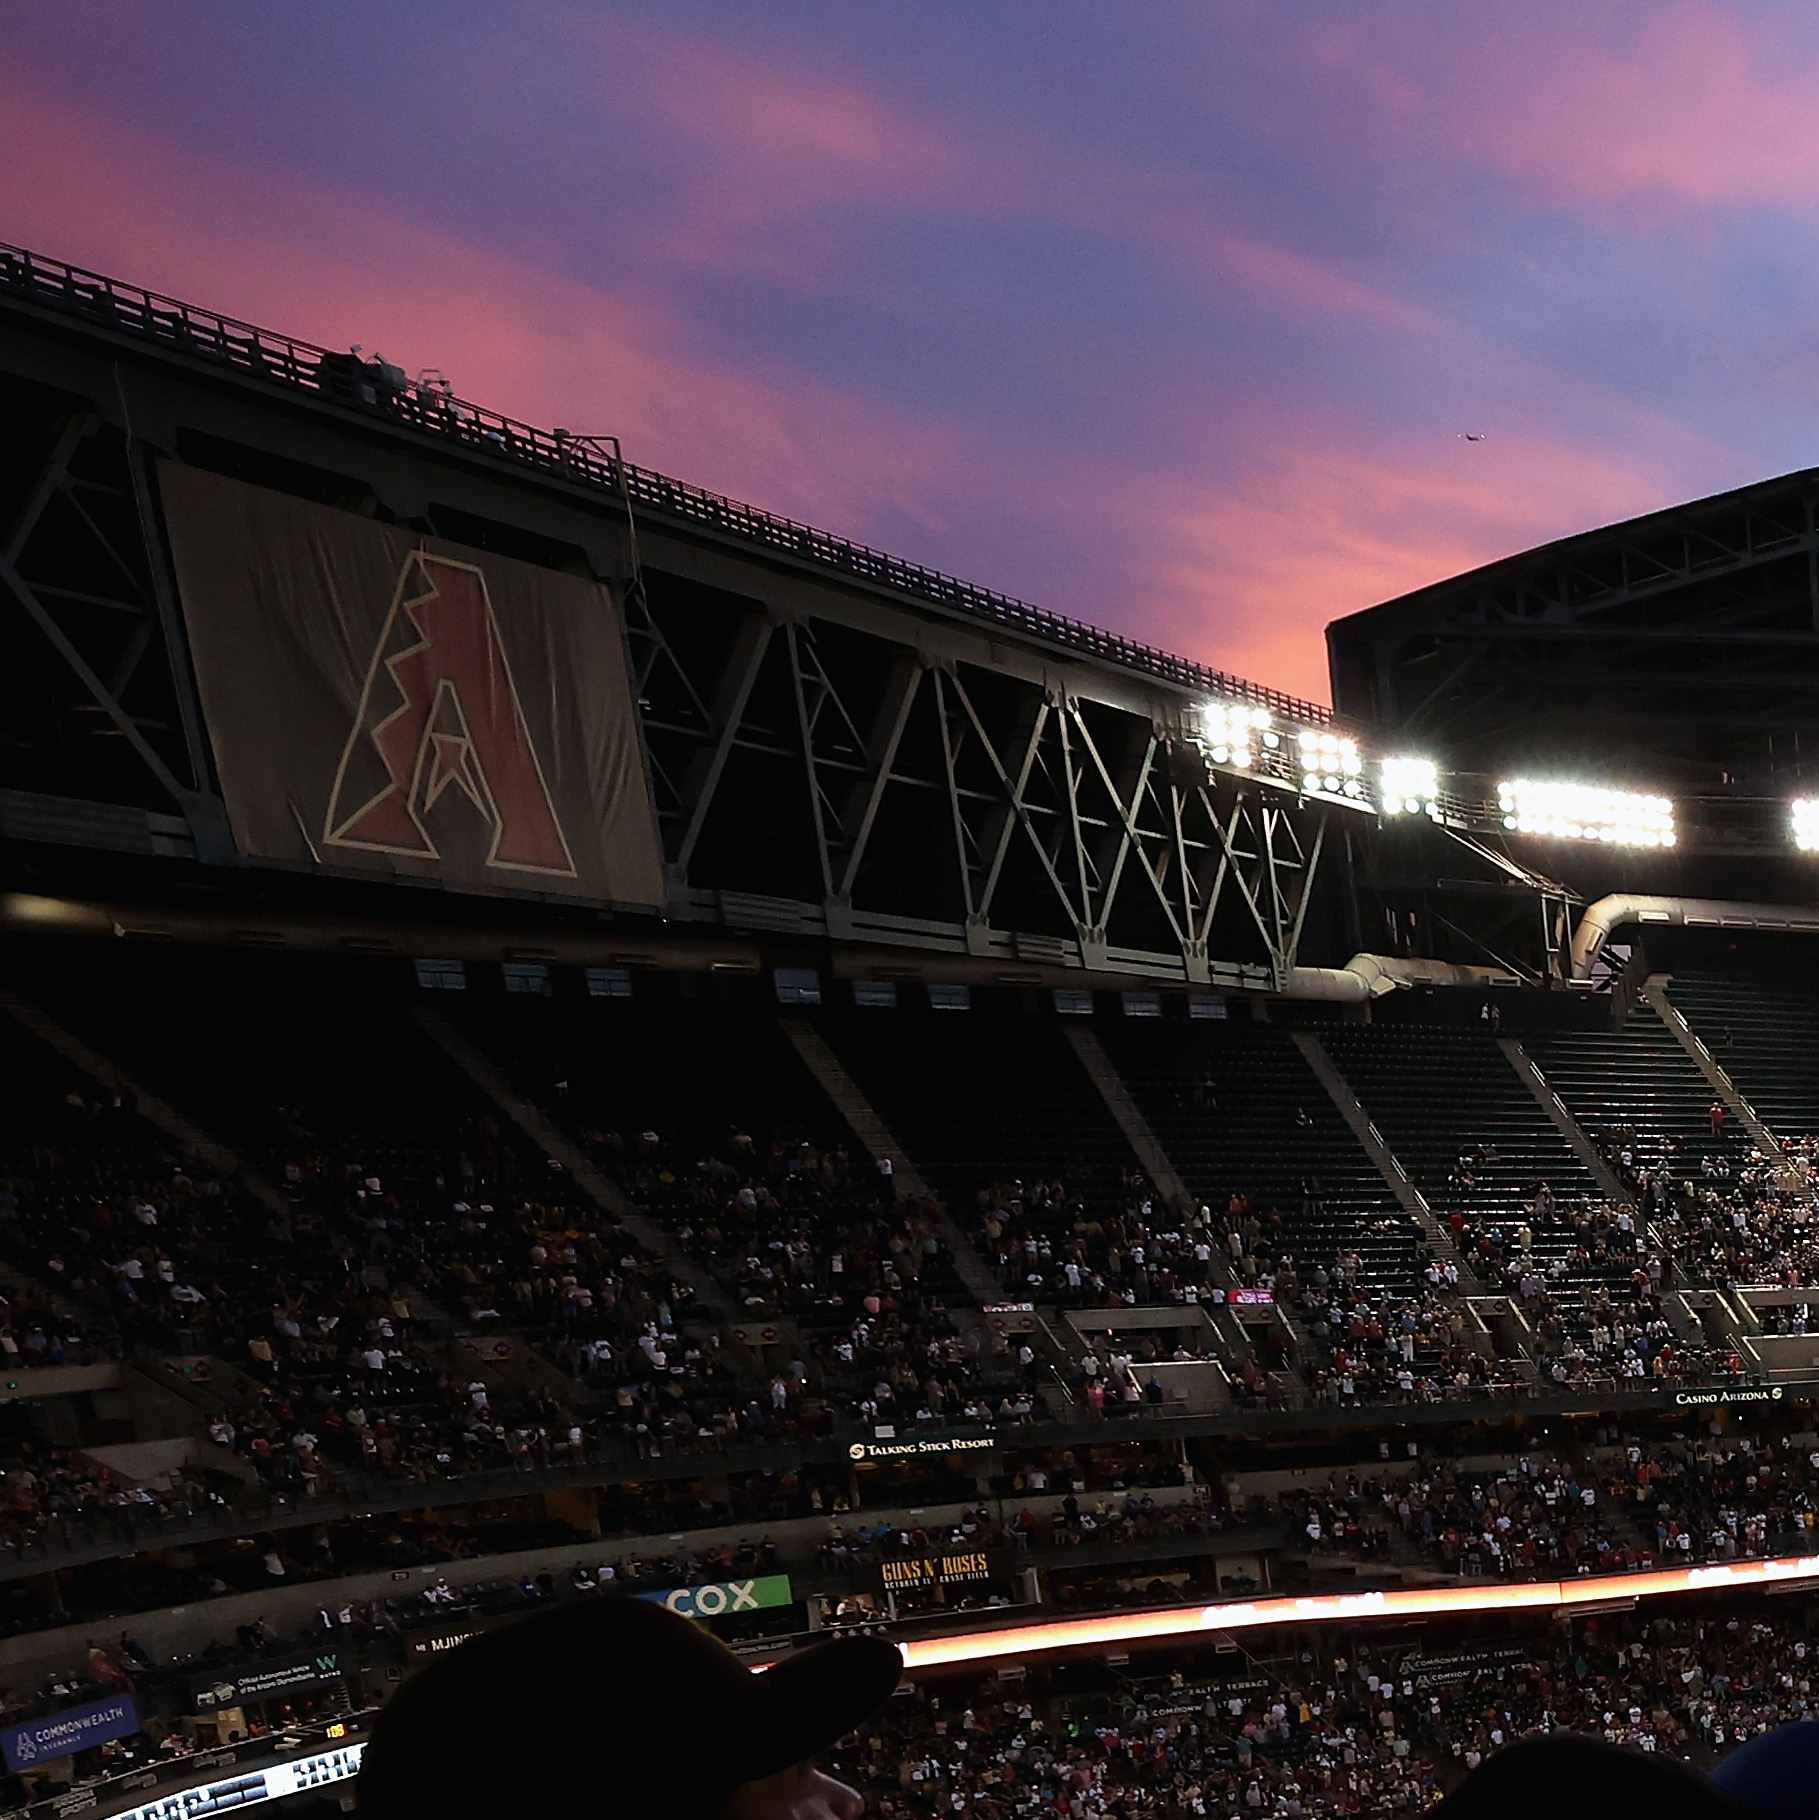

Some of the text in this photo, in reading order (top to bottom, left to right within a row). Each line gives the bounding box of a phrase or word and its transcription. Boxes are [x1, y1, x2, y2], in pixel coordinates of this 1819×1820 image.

[1676, 1391, 1769, 1406] CASINO ARIZONA
[867, 1438, 995, 1456] TALKING STICK RESORT
[882, 1560, 921, 1582] GUNS
[942, 1553, 988, 1575] ROSES
[666, 1580, 758, 1617] COX
[1226, 1679, 1270, 1690] TERRACE
[35, 1708, 124, 1743] COMMONWEALTH
